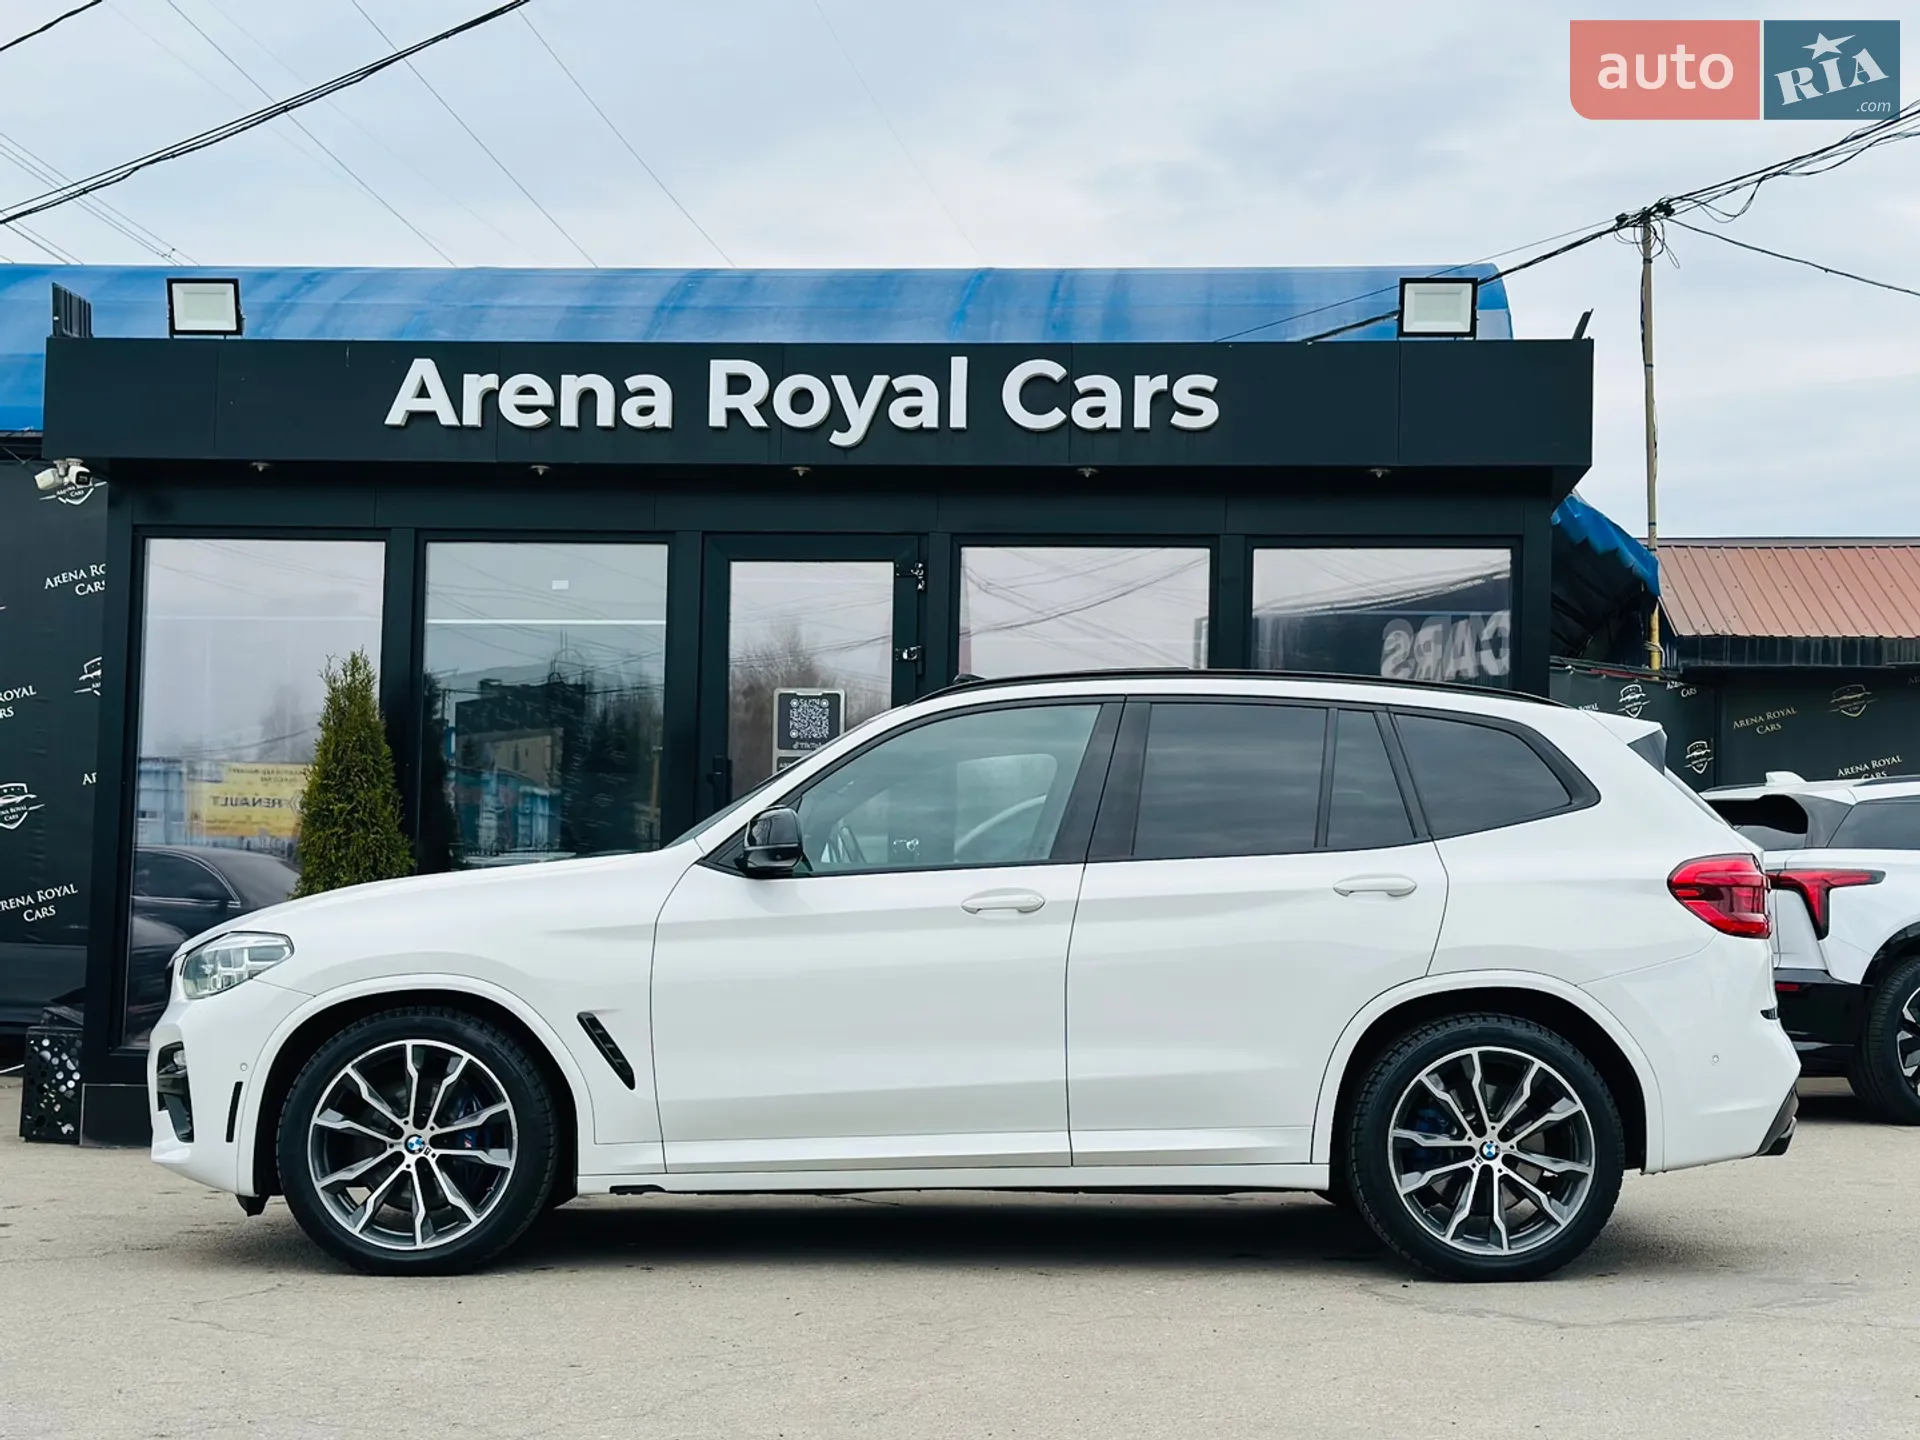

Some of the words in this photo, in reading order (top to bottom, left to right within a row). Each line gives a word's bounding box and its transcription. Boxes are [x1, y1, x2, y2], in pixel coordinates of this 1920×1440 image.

[384, 358, 673, 430] Arena
[708, 356, 968, 448] Royal
[1002, 358, 1220, 432] Cars
[44, 569, 87, 590] ARENA
[1733, 716, 1764, 730] ARENA
[1766, 707, 1797, 720] ROYAL
[1756, 723, 1782, 735] CARS
[1837, 763, 1870, 778] ARENA
[1871, 755, 1903, 769] ROYAL
[37, 884, 79, 903] ROYAL
[23, 904, 56, 922] CARS
